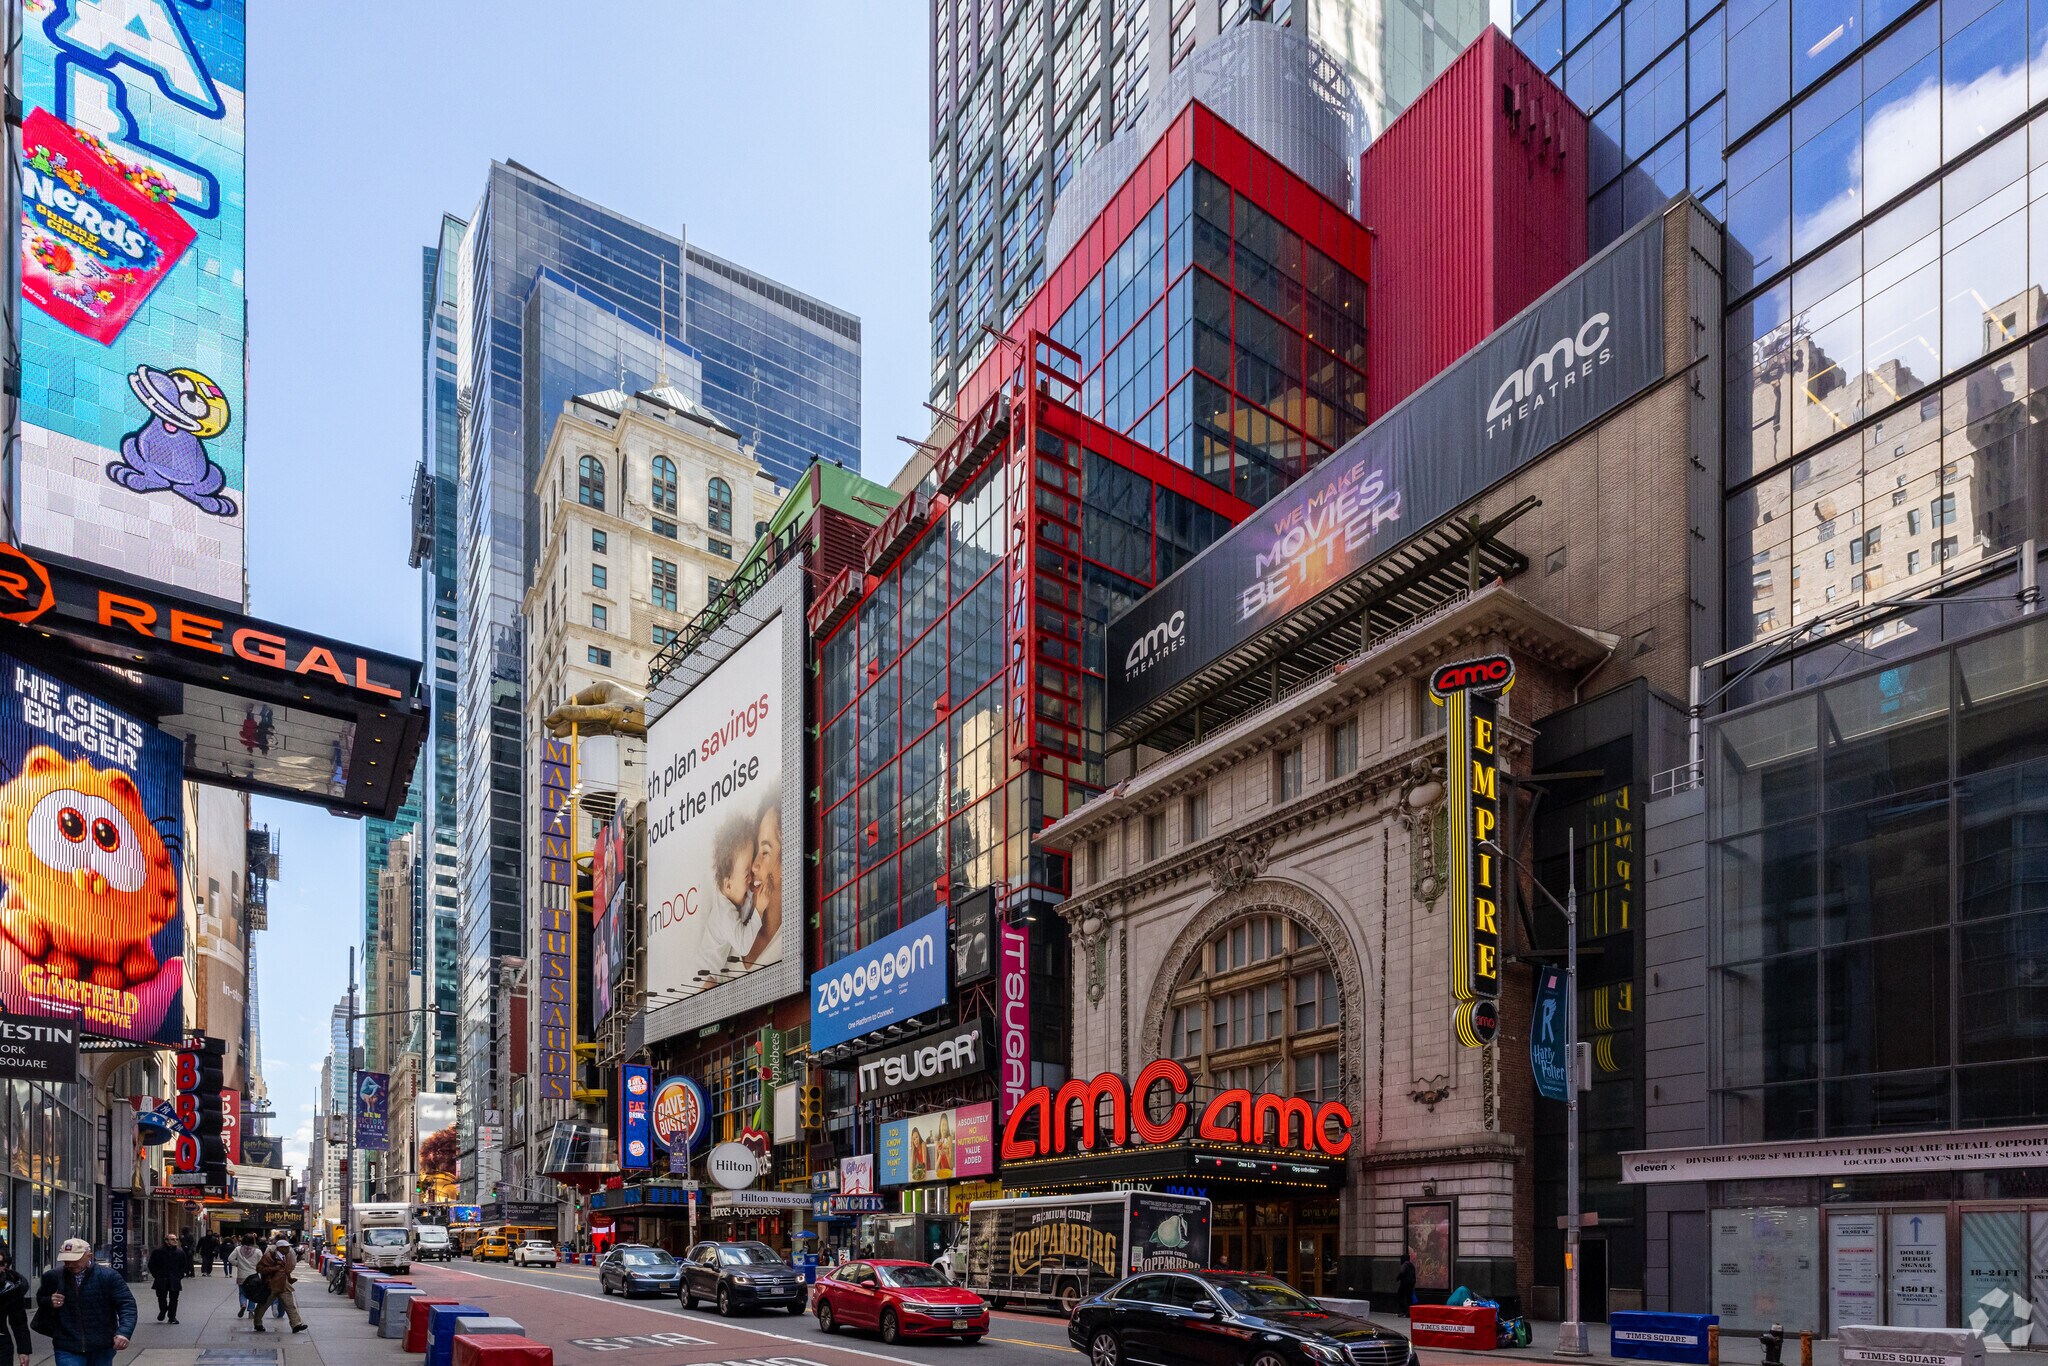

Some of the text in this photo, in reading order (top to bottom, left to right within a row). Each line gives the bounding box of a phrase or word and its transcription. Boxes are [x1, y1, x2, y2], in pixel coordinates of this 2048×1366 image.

[1486, 347, 1612, 440] THEATRES
[1274, 459, 1365, 536] WE MAKE
[1255, 469, 1384, 579] MOVIES
[1240, 491, 1402, 620] BETTER
[98, 590, 402, 699] REGAL
[1125, 635, 1185, 682] THEATRES
[16, 667, 61, 712] HE
[67, 694, 143, 748] GETS
[24, 697, 137, 770] BIGGER
[701, 693, 769, 762] savings
[664, 748, 697, 790] plan
[679, 789, 706, 826] the
[710, 755, 759, 808] noise
[545, 744, 568, 883] MADAME
[1472, 715, 1498, 980] EMPIRE
[20, 963, 139, 1015] GARFIELD
[546, 909, 568, 1099] TUSSAUDS
[85, 1007, 131, 1029] MOVIE
[0, 1021, 73, 1044] ESTIN
[1533, 1044, 1555, 1064] Harry
[1541, 1060, 1565, 1080] Potter
[175, 1052, 201, 1173] BBQ
[658, 1094, 685, 1120] DAVE
[221, 1093, 237, 1155] arget
[958, 1115, 989, 1127] ABSOLUTELY
[887, 1138, 901, 1147] KNOW
[957, 1136, 989, 1146] NUTRITIONAL
[965, 1146, 981, 1154] VALUE
[889, 1149, 899, 1157] YOU
[964, 1156, 982, 1165] ADDED
[1686, 1155, 1734, 1164] DIVISIBLE
[1768, 1152, 1781, 1160] SF
[1783, 1146, 1854, 1159] MULTI-LEVEL
[1856, 1147, 1892, 1156] TIMES
[1894, 1143, 1943, 1154] SQUARE
[1948, 1141, 1992, 1151] RETAIL
[1844, 1150, 2043, 1166] LOCATED ABOVE NYC'S BUSIEST SUBWAY
[716, 1160, 752, 1173] Hilton
[1634, 1163, 1668, 1172] eleven
[741, 1194, 768, 1202] Hilton
[955, 1190, 998, 1200] WORLD'S LARGEST
[1167, 1185, 1207, 1197] IMAX
[113, 1200, 124, 1225] TIER
[265, 1211, 302, 1224] Harry Potter
[1032, 1209, 1091, 1224] PREMIUM CIDER
[113, 1251, 124, 1270] 245
[1009, 1223, 1117, 1277] KOPPARBERG
[2004, 1269, 2019, 1277] FT
[572, 1332, 719, 1351] BUS
[1626, 1332, 1687, 1343] TIMES SQUARE
[1859, 1352, 1946, 1366] TIMES SQUARE
